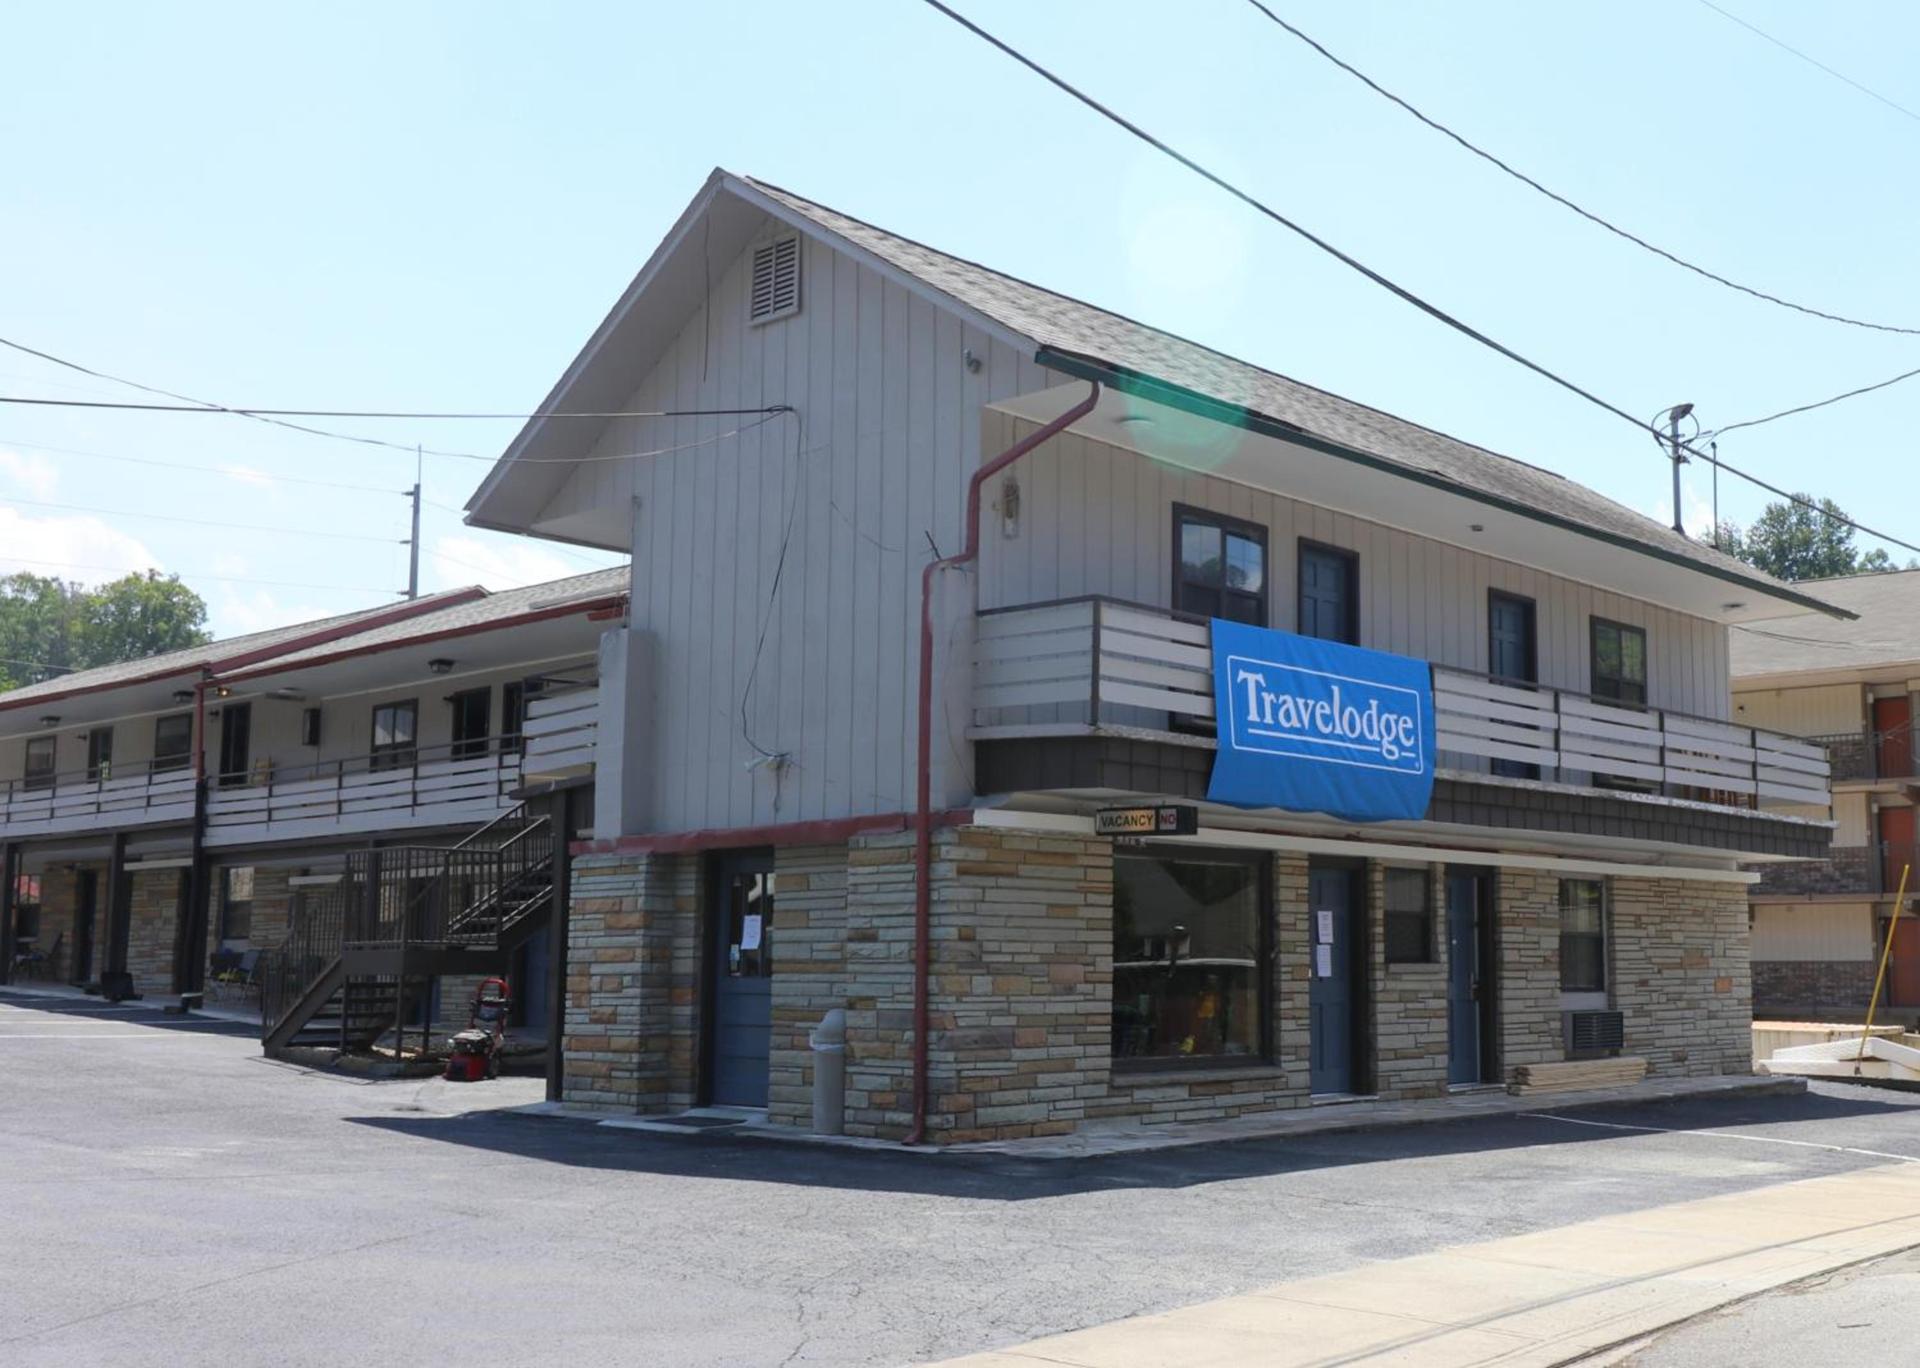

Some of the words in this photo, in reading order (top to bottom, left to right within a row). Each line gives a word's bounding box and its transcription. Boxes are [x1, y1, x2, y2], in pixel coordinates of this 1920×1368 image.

[1236, 669, 1415, 760] Travelodge
[1100, 814, 1153, 828] VACANCY
[1160, 814, 1176, 825] NO
